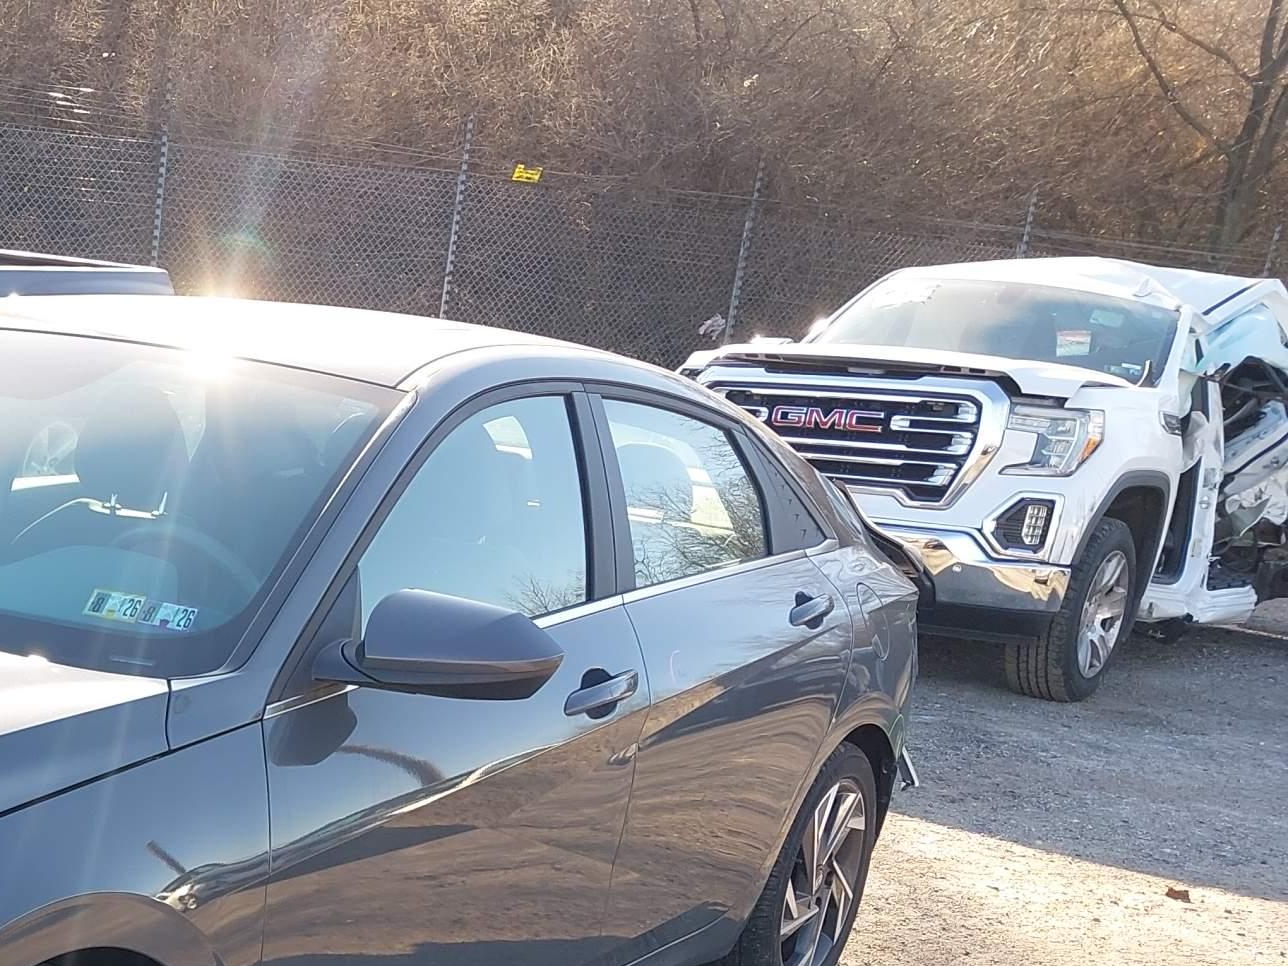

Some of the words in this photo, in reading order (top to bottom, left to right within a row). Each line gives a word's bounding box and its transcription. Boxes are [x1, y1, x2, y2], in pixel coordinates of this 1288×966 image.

[772, 405, 885, 432] GMC
[123, 598, 142, 618] 26
[175, 608, 196, 629] 26
